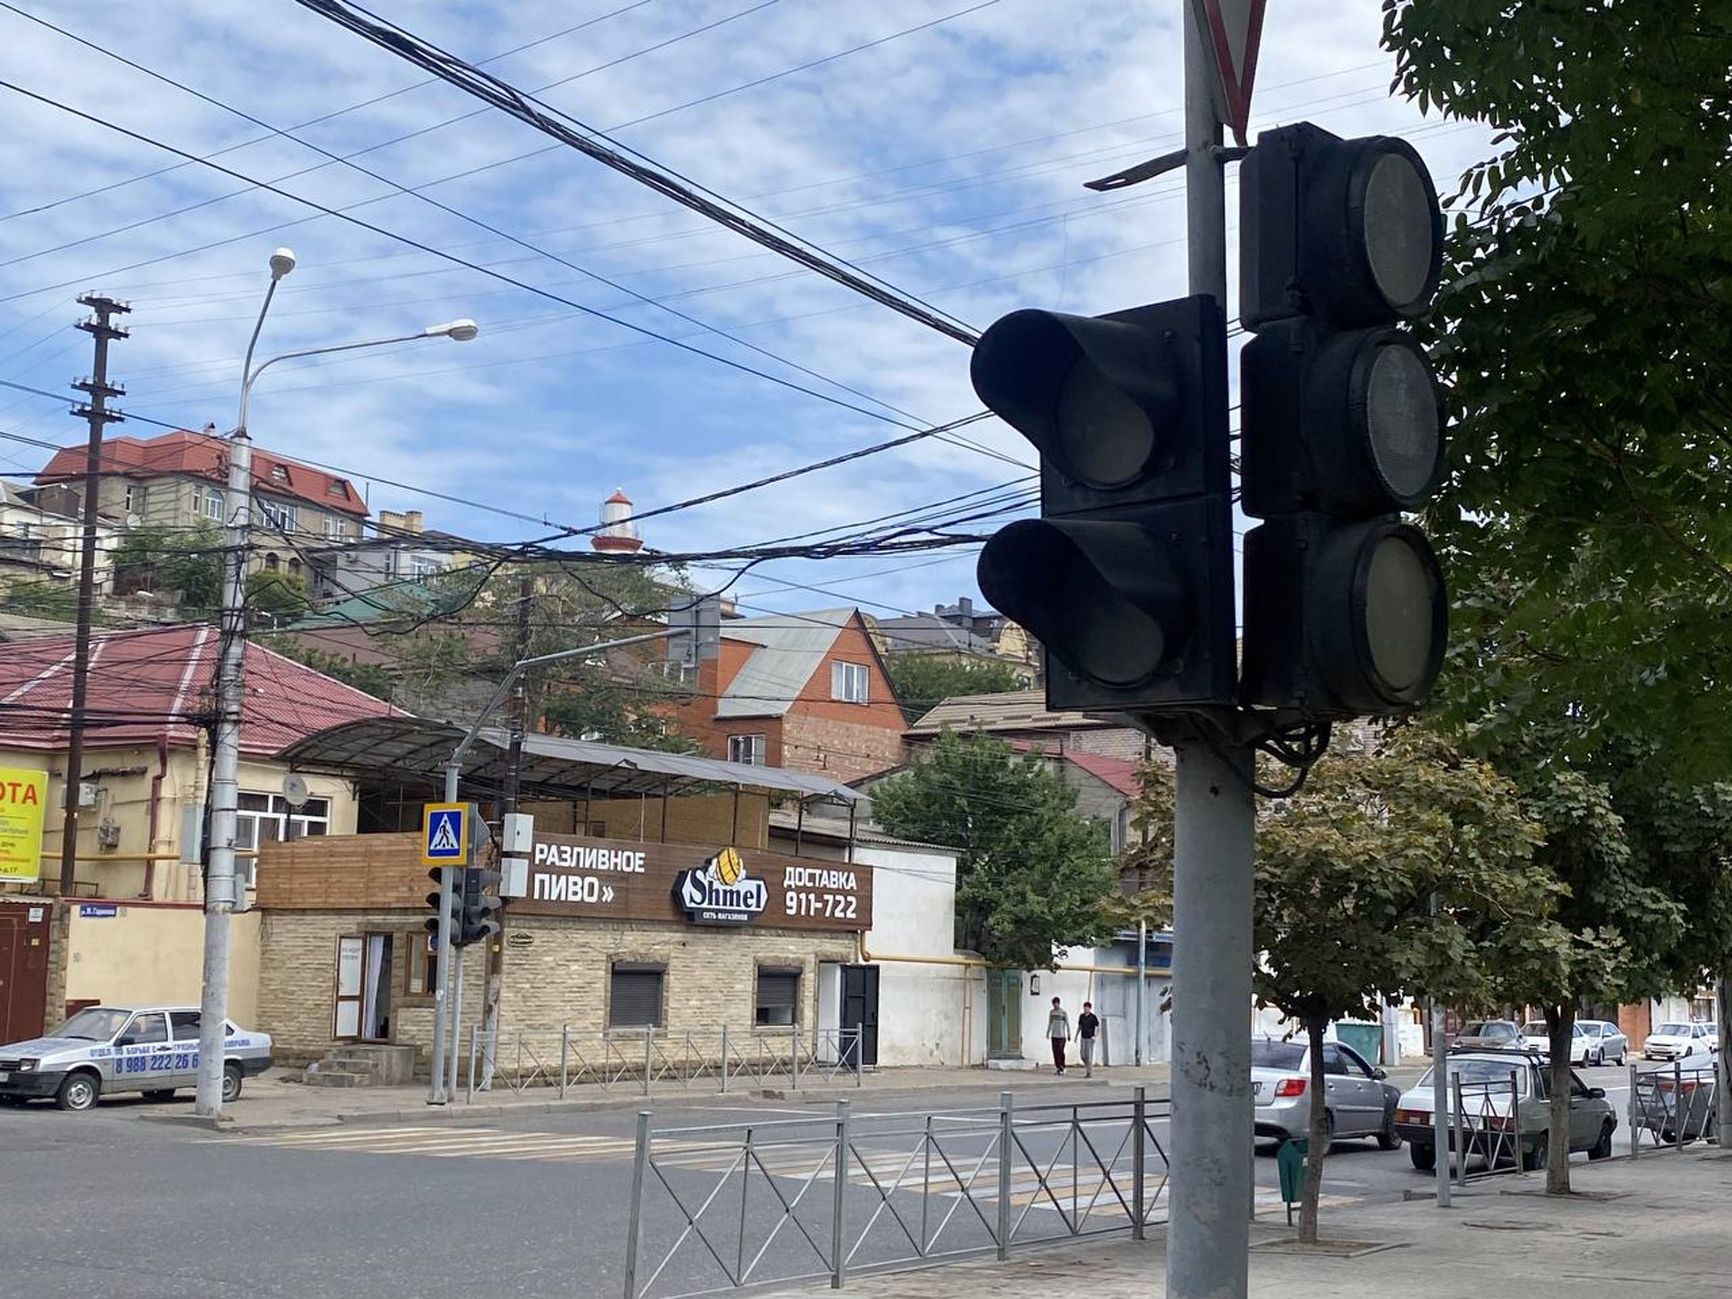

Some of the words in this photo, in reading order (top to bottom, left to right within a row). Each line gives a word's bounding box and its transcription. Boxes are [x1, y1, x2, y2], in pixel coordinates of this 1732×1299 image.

[534, 843, 646, 873] РАЗЛИВНОЕ
[689, 868, 762, 908] Shmel
[783, 866, 857, 890] ДОСТАВКА
[785, 891, 857, 918] 911-722
[115, 1058, 123, 1074] 8
[126, 1056, 146, 1073] 988
[150, 1055, 171, 1070] 222
[175, 1054, 189, 1069] 26
